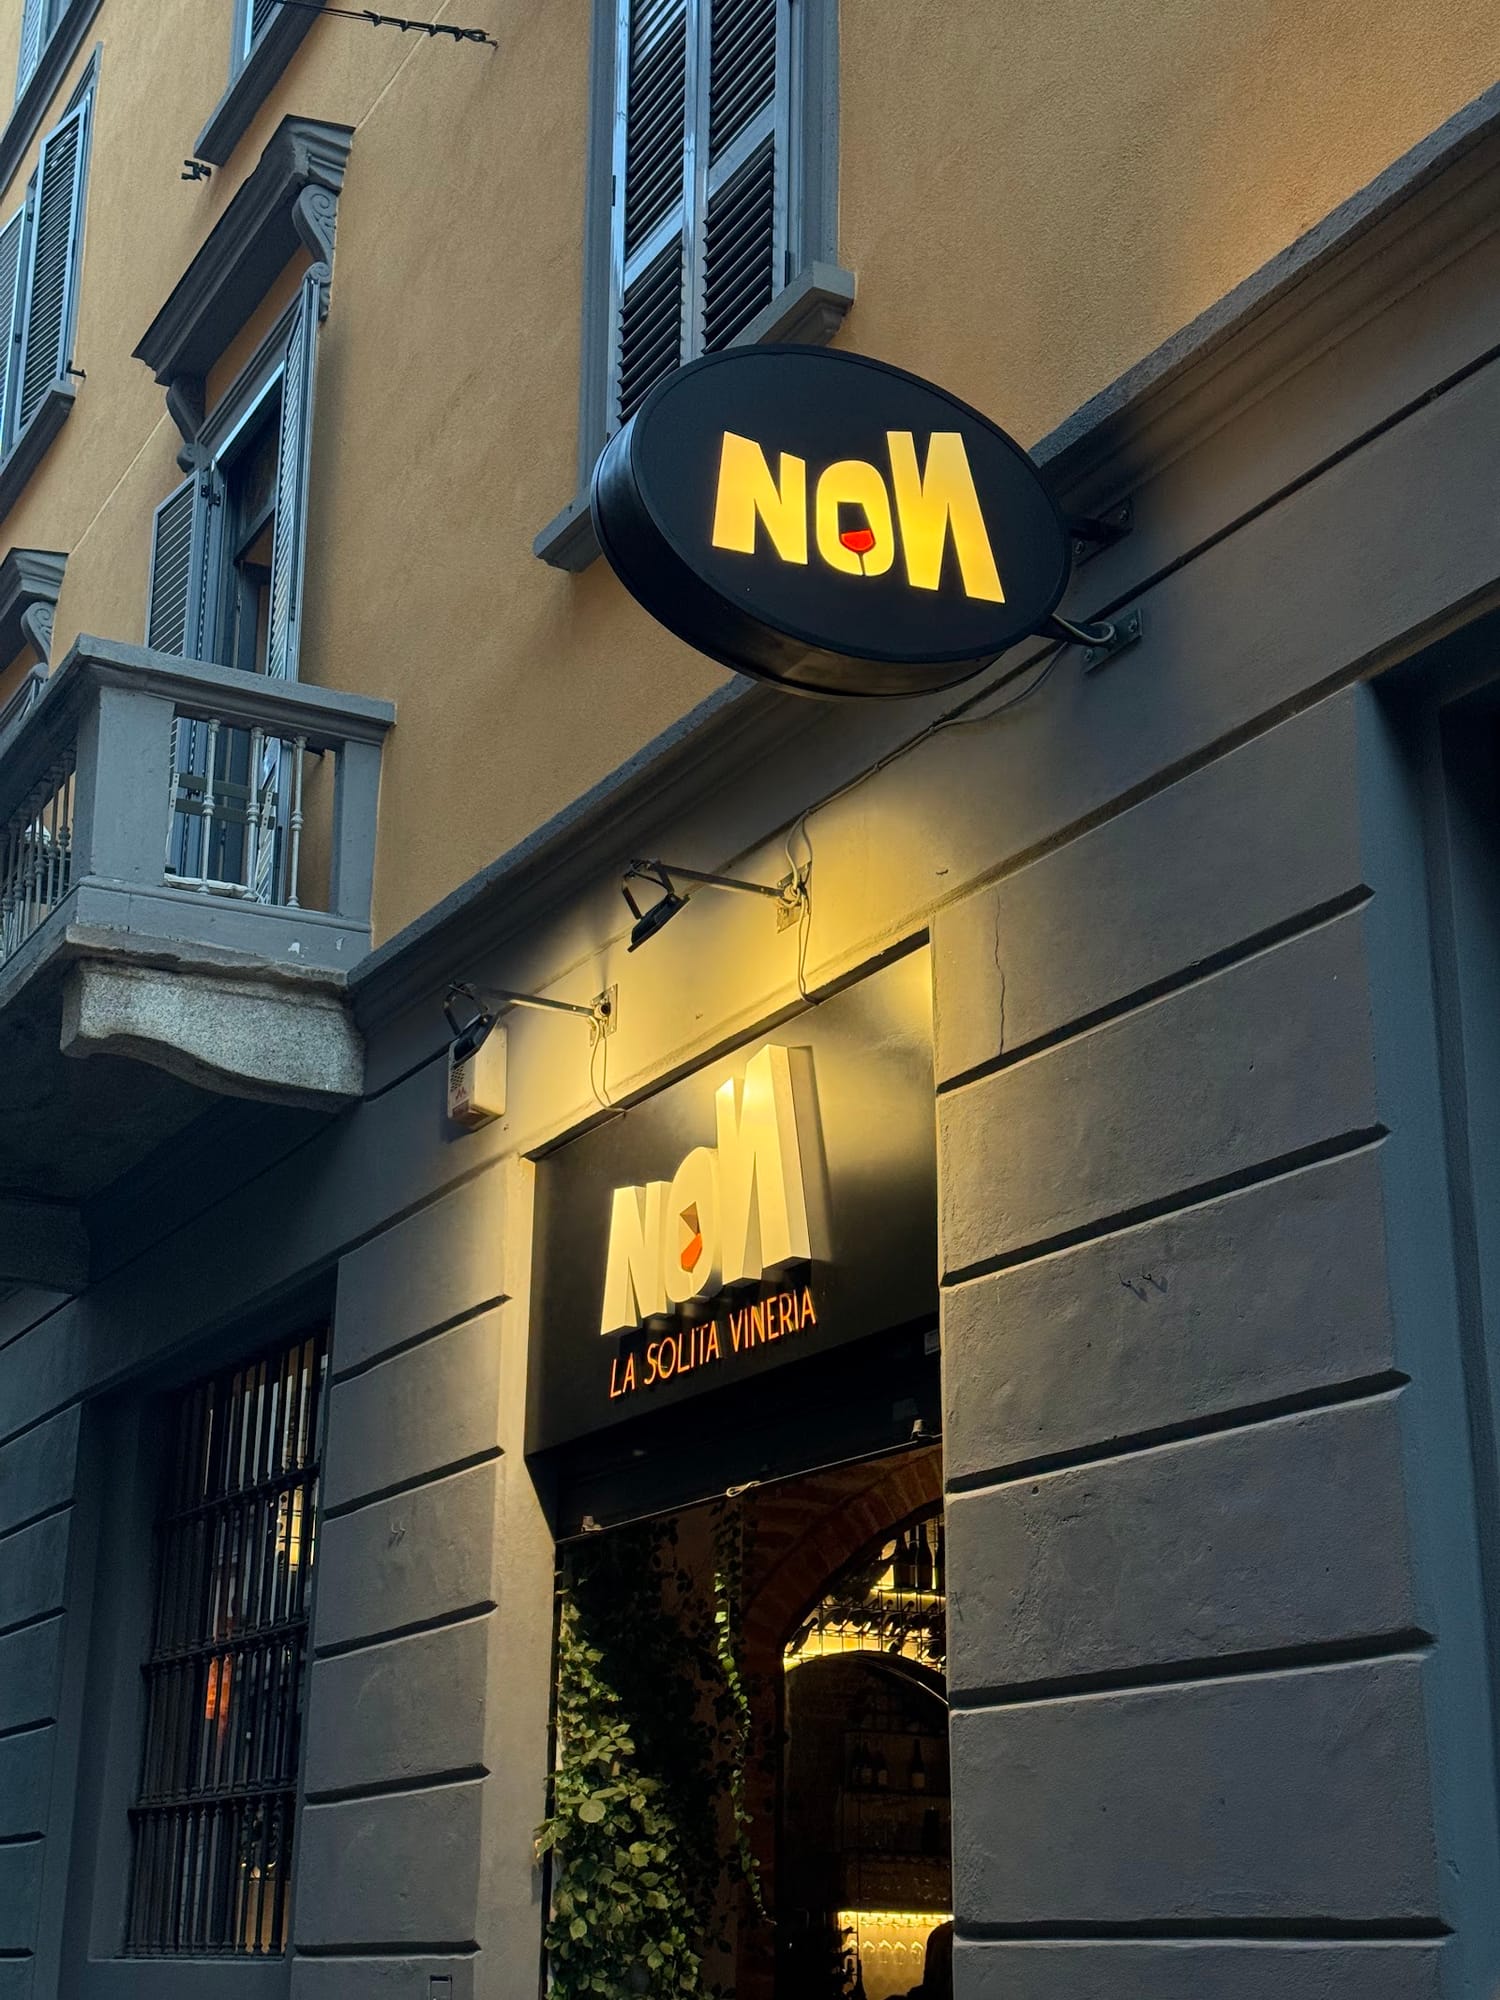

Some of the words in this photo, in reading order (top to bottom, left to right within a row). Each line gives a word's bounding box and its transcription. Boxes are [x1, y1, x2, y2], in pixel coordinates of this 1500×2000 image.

[610, 1352, 636, 1398] LA
[644, 1320, 720, 1385] SOLITA
[729, 1286, 817, 1352] VINERIA
